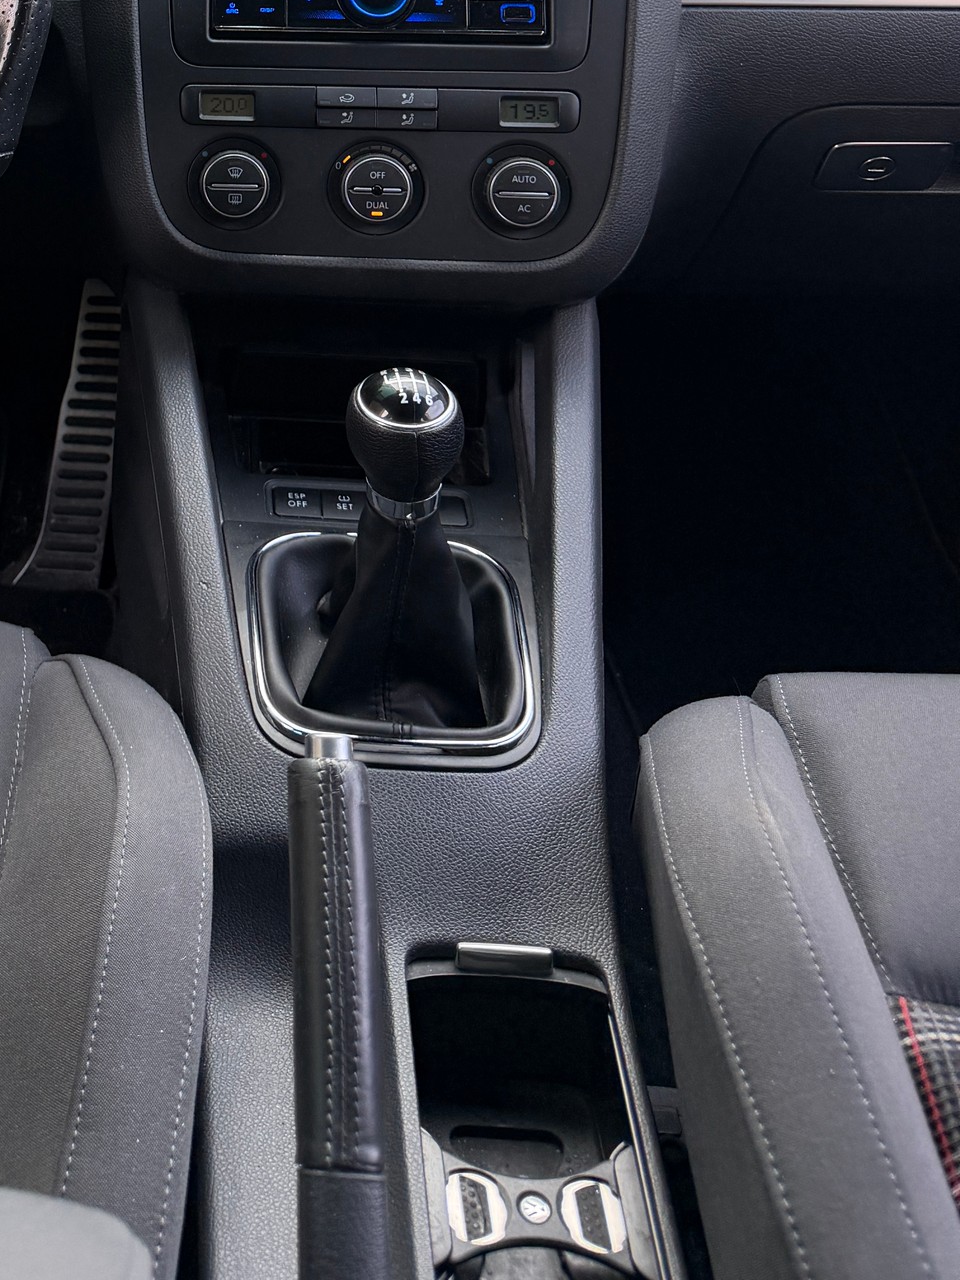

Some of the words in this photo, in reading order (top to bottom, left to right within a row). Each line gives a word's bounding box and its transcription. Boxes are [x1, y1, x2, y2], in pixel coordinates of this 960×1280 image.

[210, 97, 248, 113] 20.0
[510, 104, 550, 120] 19.5
[369, 171, 386, 180] OFF
[511, 175, 537, 184] AUTO
[366, 200, 389, 210] DUAL
[517, 204, 531, 213] AC
[399, 392, 409, 404] 2
[412, 392, 421, 404] 4
[425, 395, 434, 406] 6
[288, 492, 306, 500] ESP
[288, 500, 308, 508] OFF
[336, 503, 353, 511] SET
